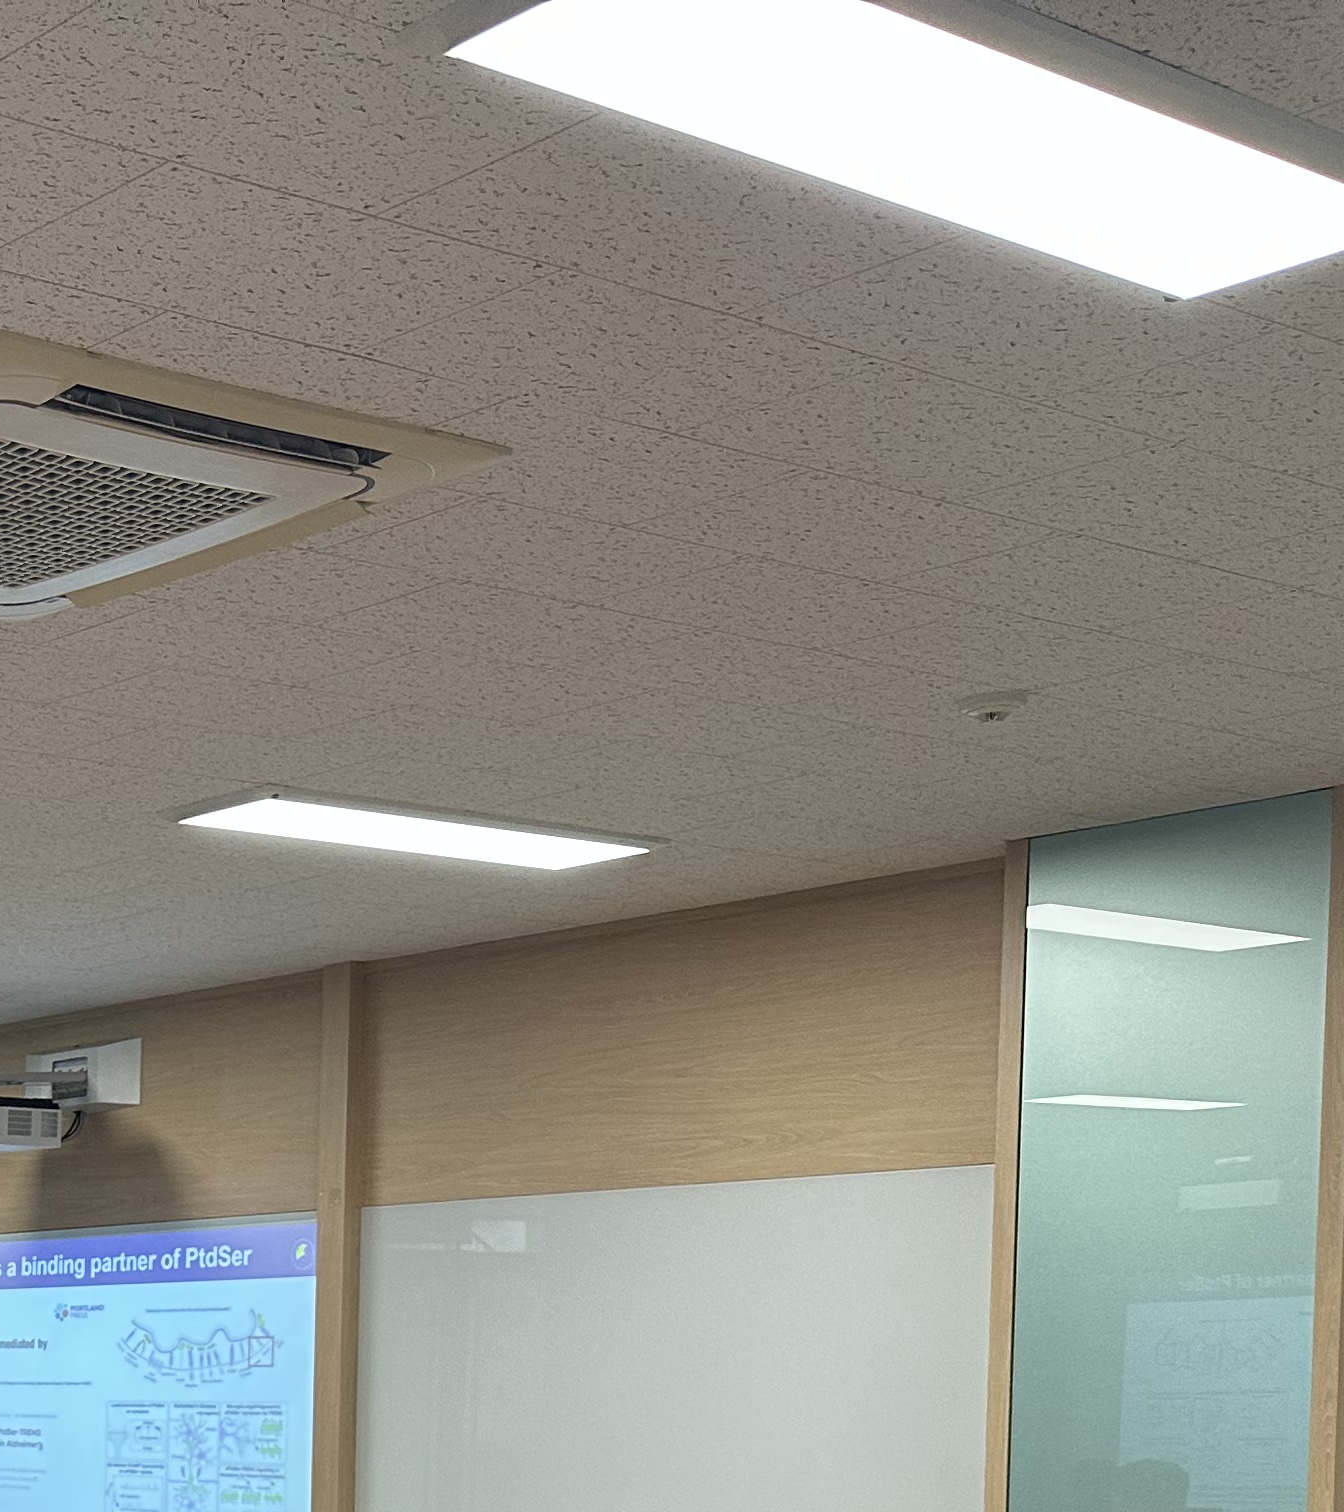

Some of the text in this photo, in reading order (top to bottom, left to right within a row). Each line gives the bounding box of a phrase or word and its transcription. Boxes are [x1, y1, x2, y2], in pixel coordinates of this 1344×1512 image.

[6, 1261, 17, 1277] a
[21, 1253, 86, 1280] binding
[90, 1251, 157, 1278] partner
[160, 1247, 182, 1270] of
[185, 1244, 254, 1269] PtdSer
[37, 1338, 48, 1350] by
